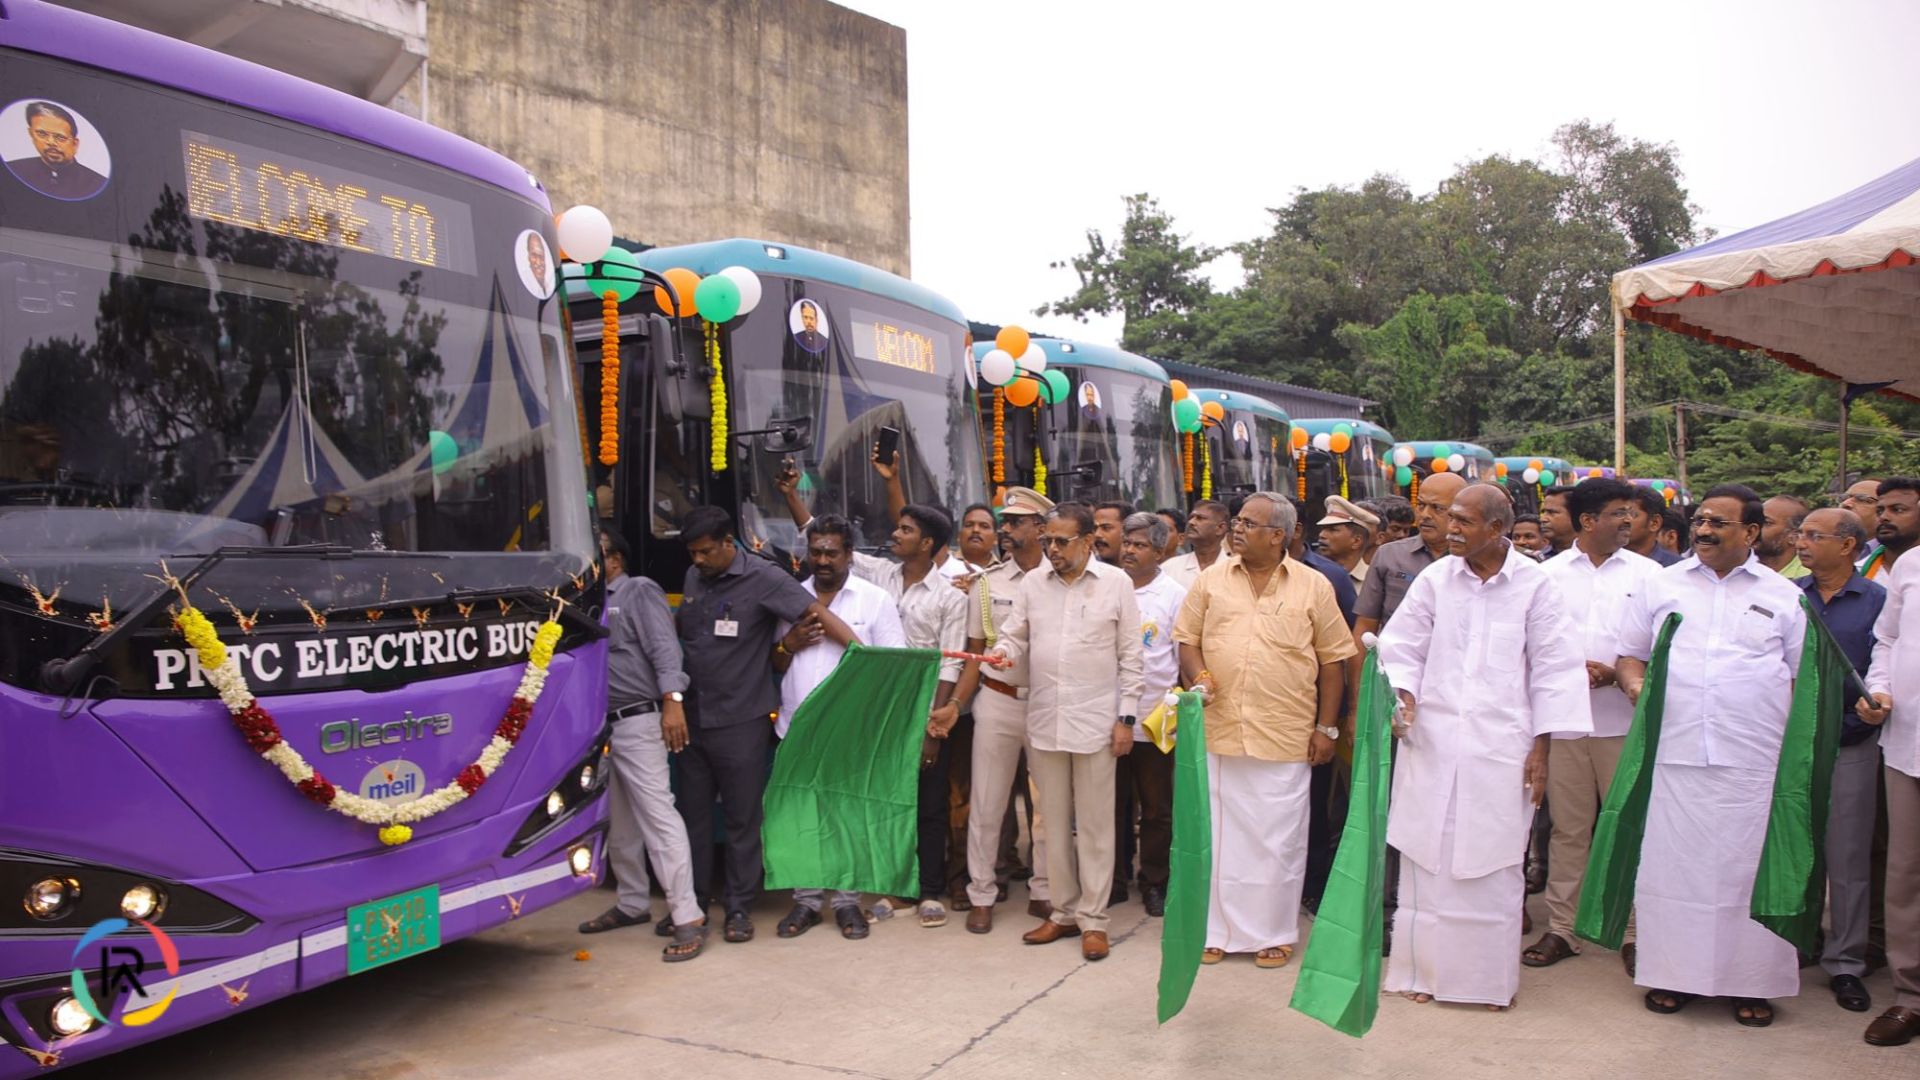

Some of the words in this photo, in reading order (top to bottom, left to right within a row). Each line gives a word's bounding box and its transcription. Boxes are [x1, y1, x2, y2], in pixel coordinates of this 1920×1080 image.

[189, 143, 374, 251] ELCOME
[381, 194, 436, 266] TO
[295, 626, 479, 678] ELECTRIC
[487, 620, 539, 658] BUS
[321, 710, 453, 754] Olectra
[369, 772, 416, 801] meil
